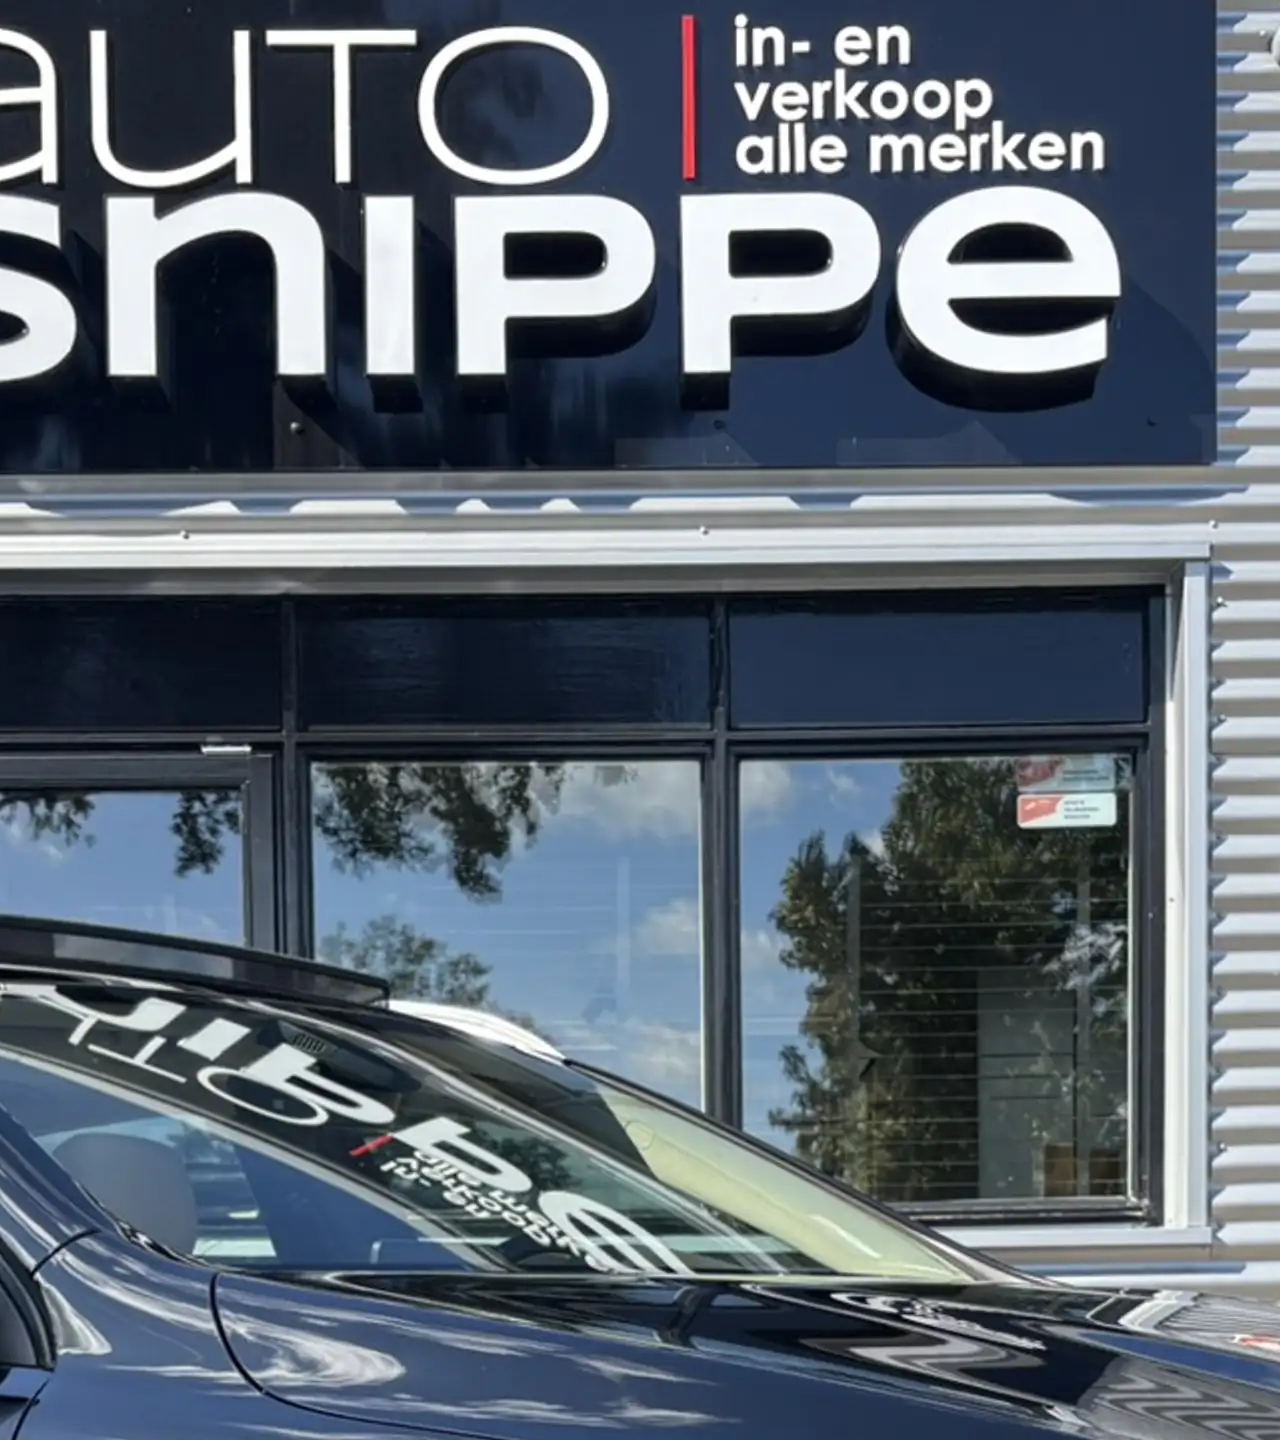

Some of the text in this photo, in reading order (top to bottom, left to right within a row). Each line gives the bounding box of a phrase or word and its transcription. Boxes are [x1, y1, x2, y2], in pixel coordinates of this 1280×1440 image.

[734, 13, 911, 67] in- en
[734, 68, 993, 131] verkoop
[736, 120, 1105, 174] alle merken
